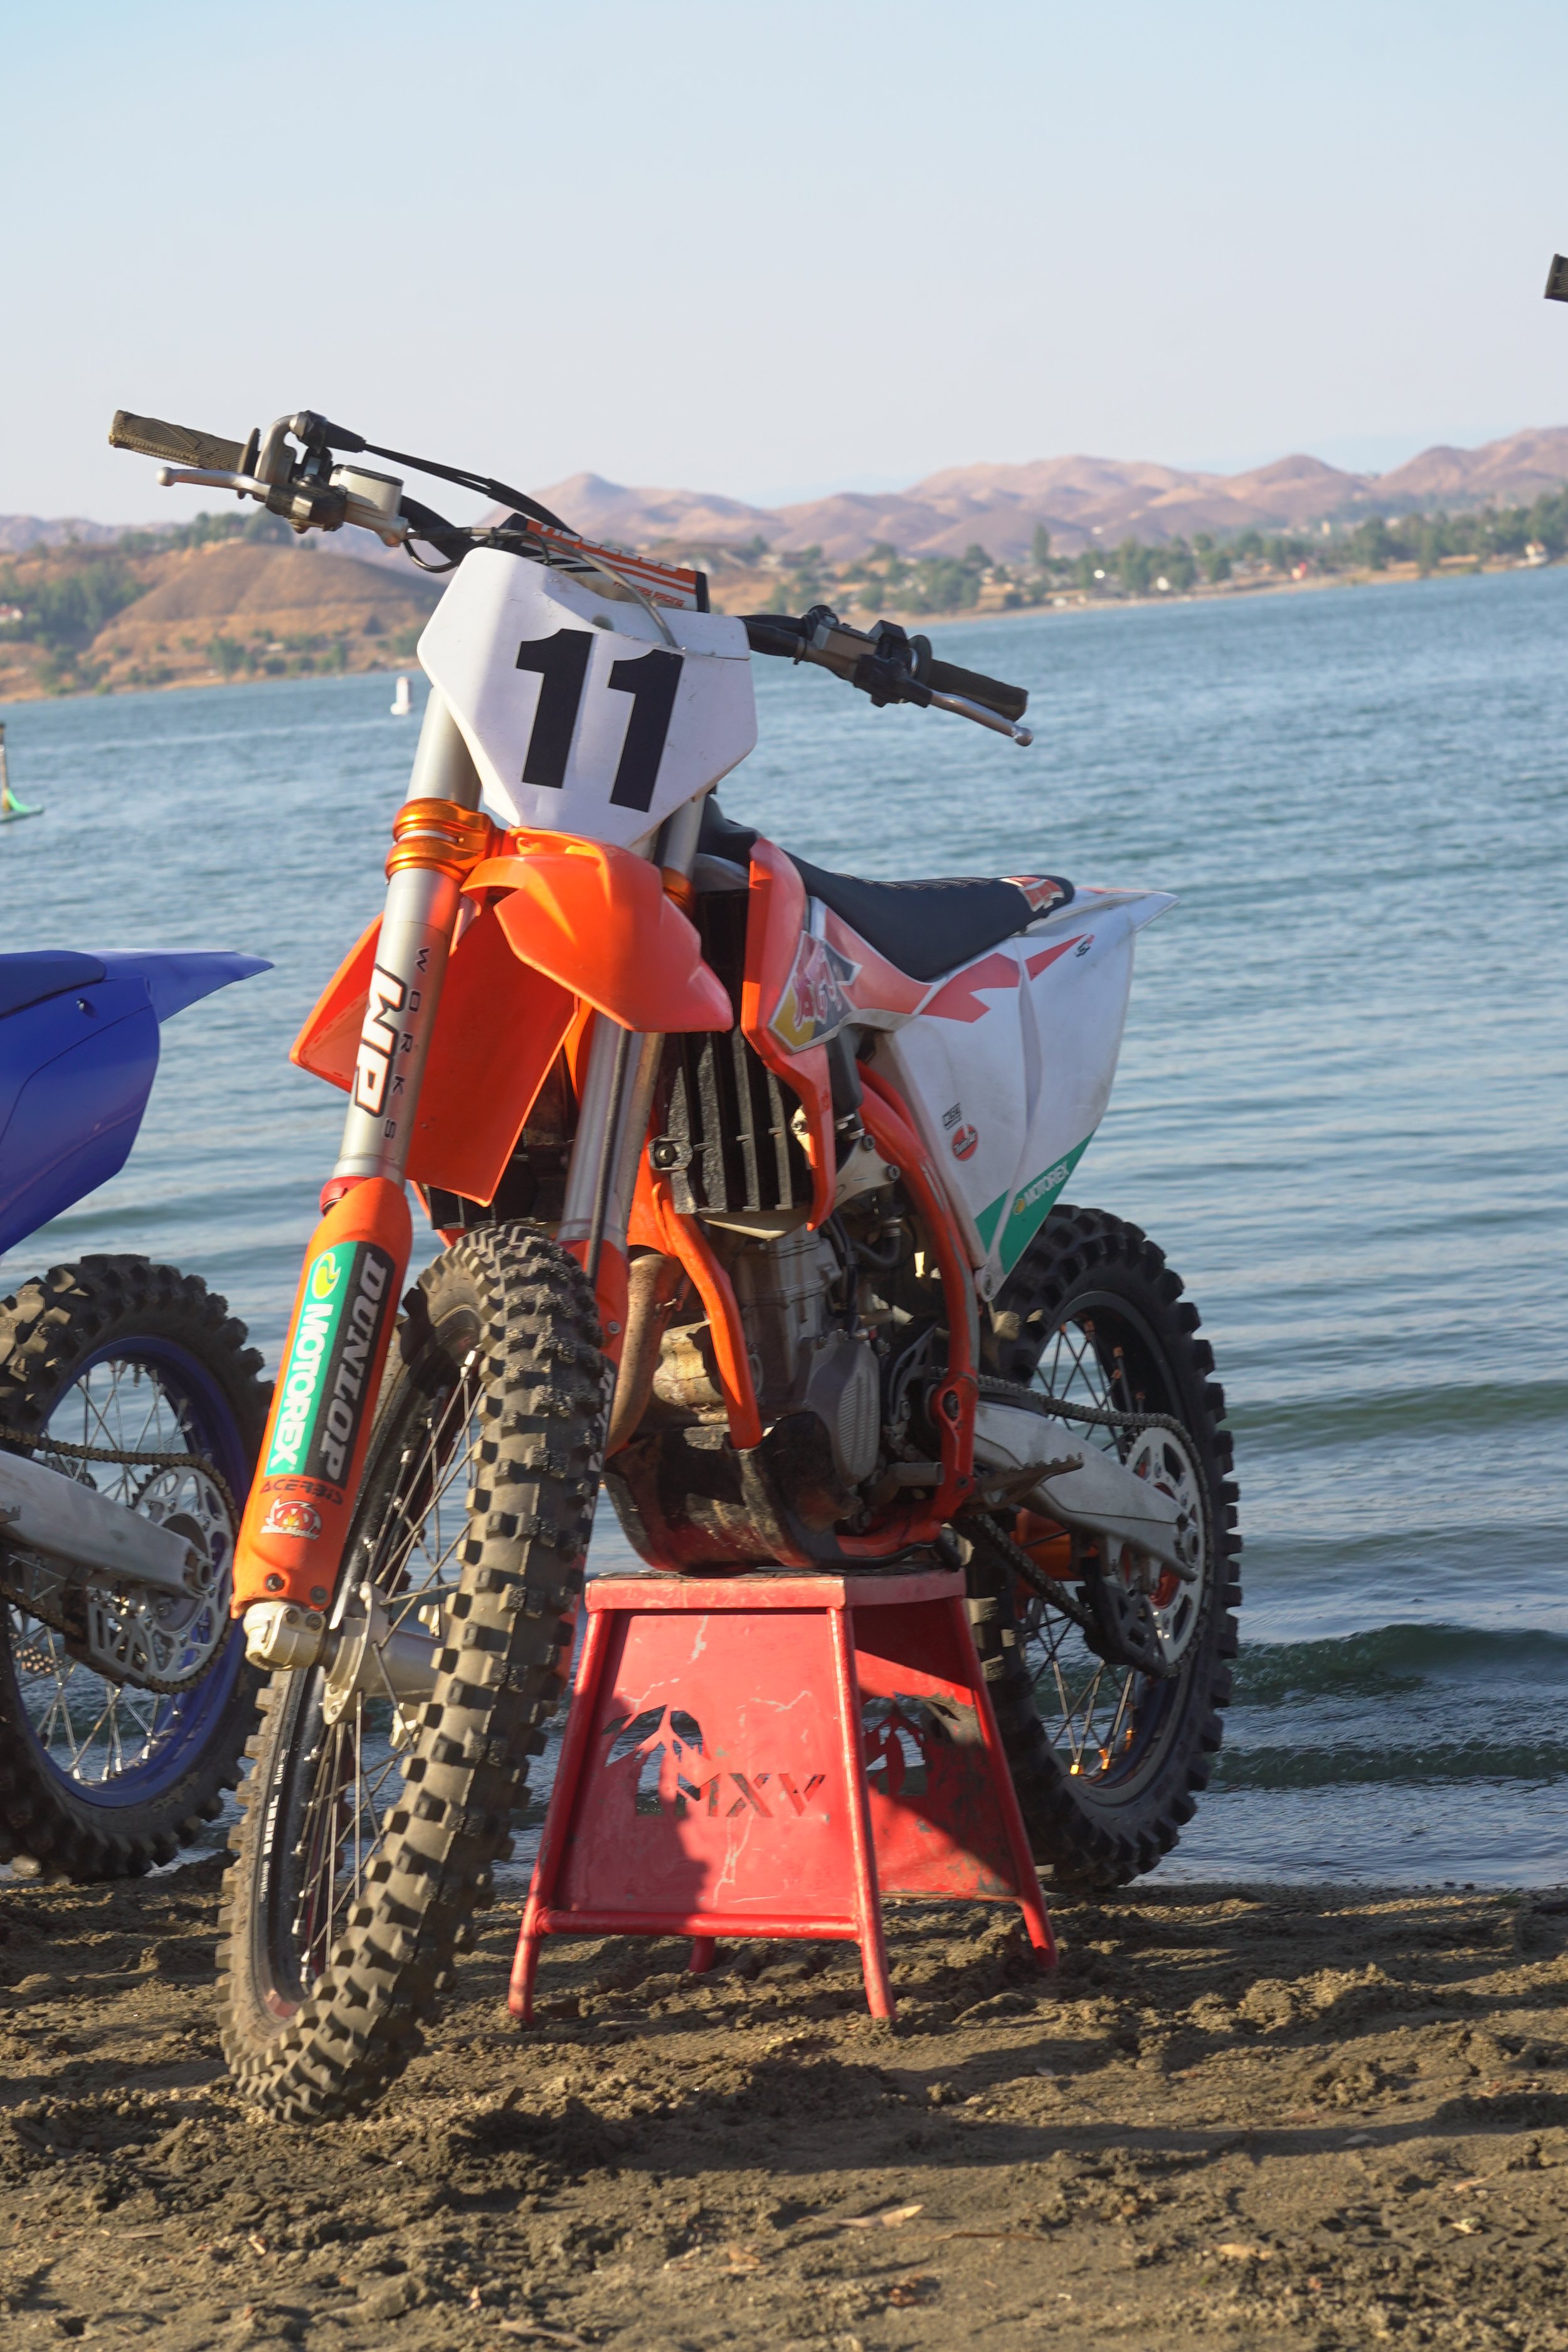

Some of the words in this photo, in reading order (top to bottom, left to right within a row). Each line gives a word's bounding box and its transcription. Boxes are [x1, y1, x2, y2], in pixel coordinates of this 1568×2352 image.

[516, 628, 684, 813] 11
[355, 963, 406, 1118] WP
[383, 947, 431, 1139] WORKS
[270, 1303, 334, 1469] MOTOREX
[320, 1252, 387, 1480] DUNLOP
[259, 1478, 343, 1505] ACERBIS
